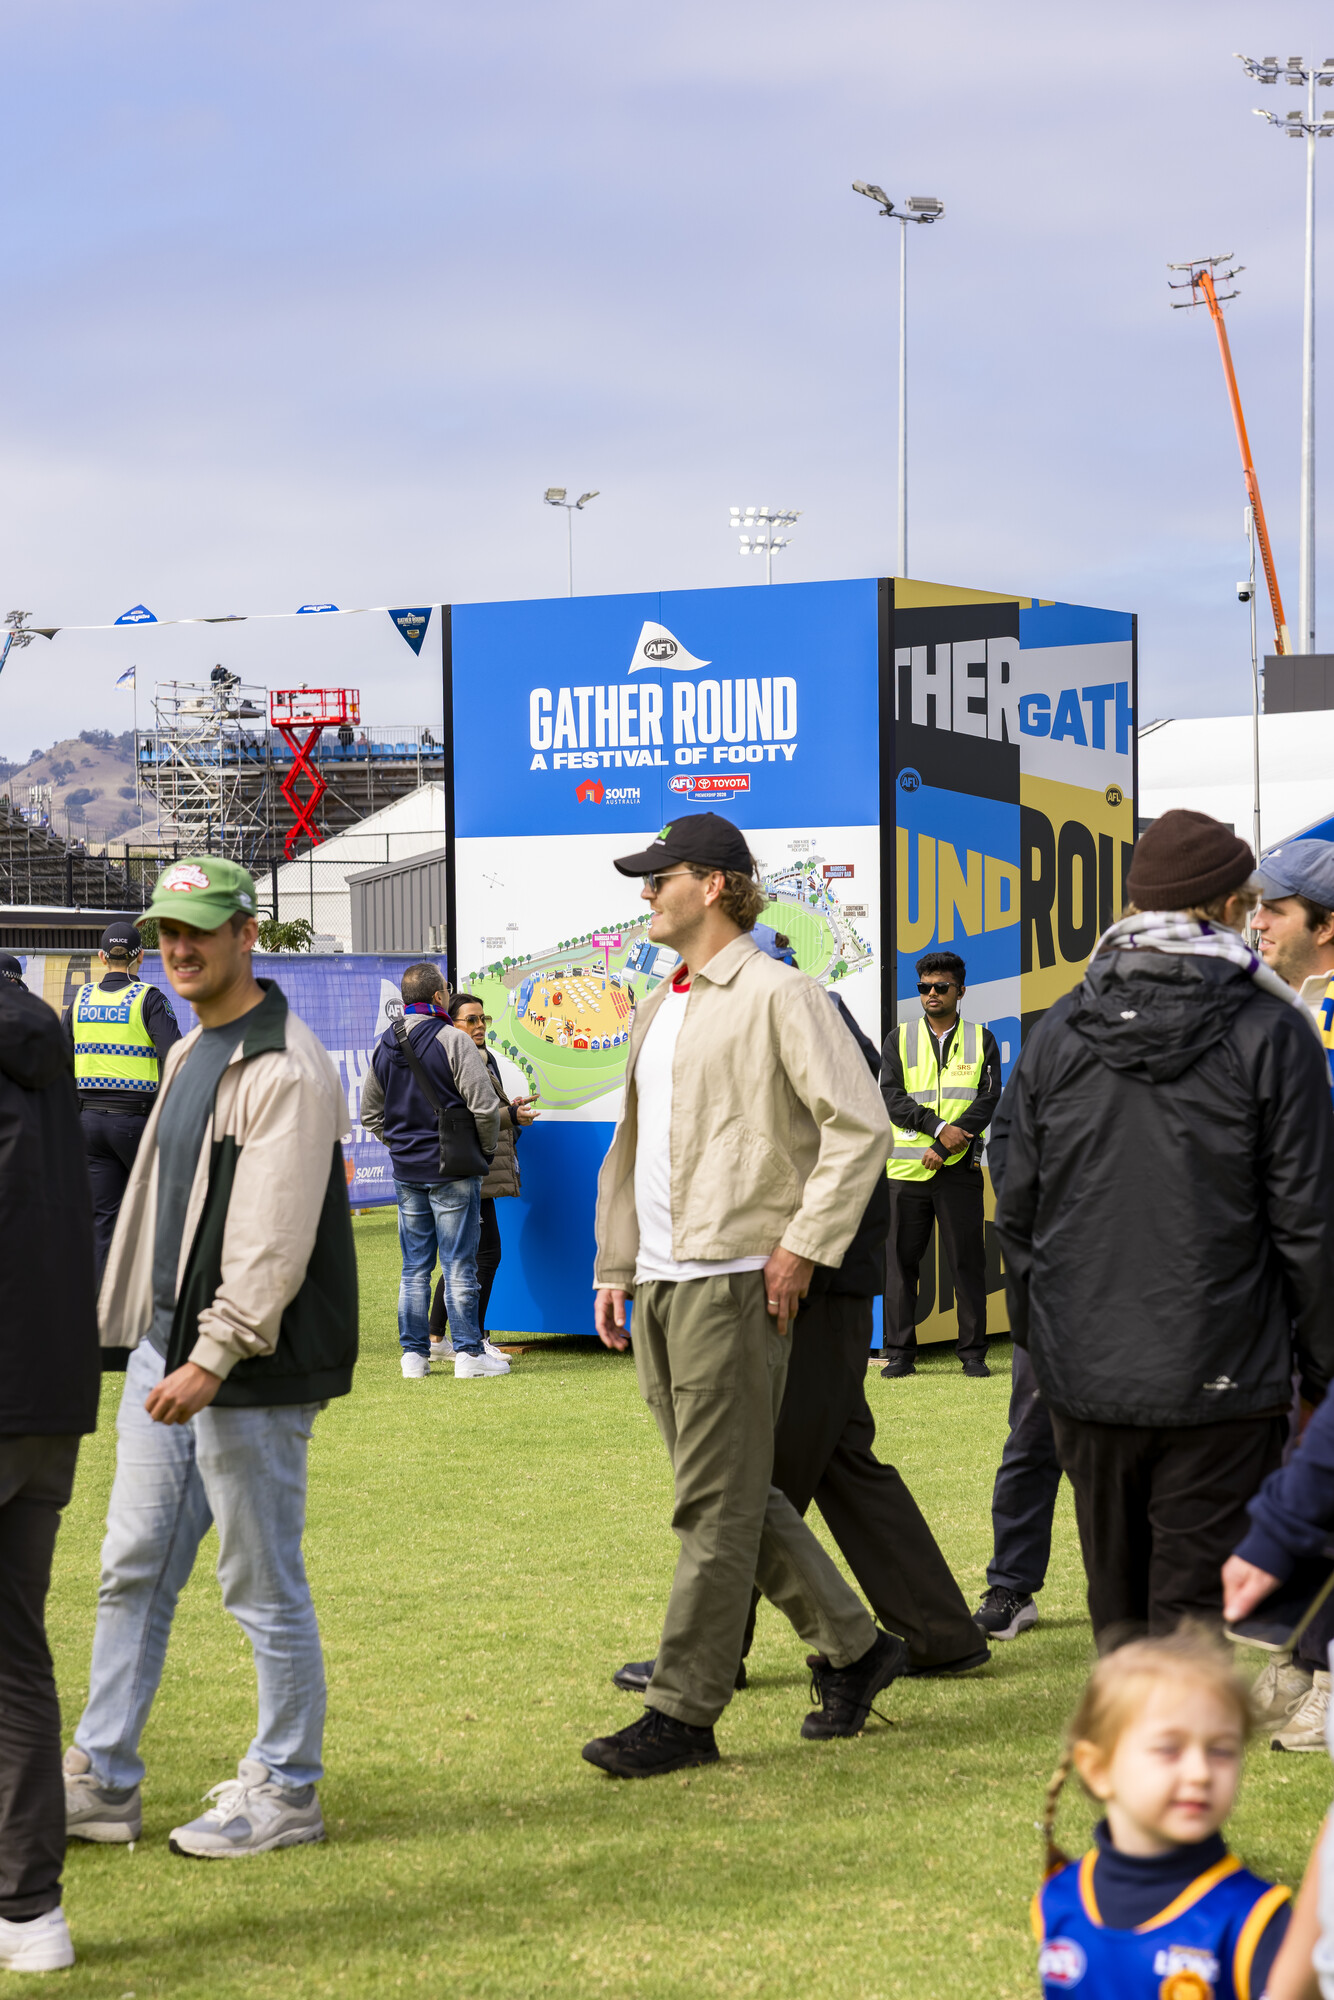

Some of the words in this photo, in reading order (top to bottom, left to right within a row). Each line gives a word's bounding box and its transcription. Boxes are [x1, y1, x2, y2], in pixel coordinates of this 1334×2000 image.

[647, 643, 676, 656] AFL
[529, 683, 664, 750] GATHER
[673, 676, 798, 745] ROUND
[530, 753, 548, 770] A
[554, 748, 669, 770] FESTIVAL
[675, 745, 708, 764] OF
[713, 743, 798, 764] FOOTY
[671, 779, 694, 789] AFL
[713, 778, 747, 788] TOYOTA
[902, 776, 918, 788] AFL
[605, 787, 640, 799] SOUTH
[1107, 792, 1121, 802] AFL
[79, 1007, 127, 1021] POLICE
[387, 1003, 405, 1018] AF
[356, 1165, 384, 1180] SOUTH
